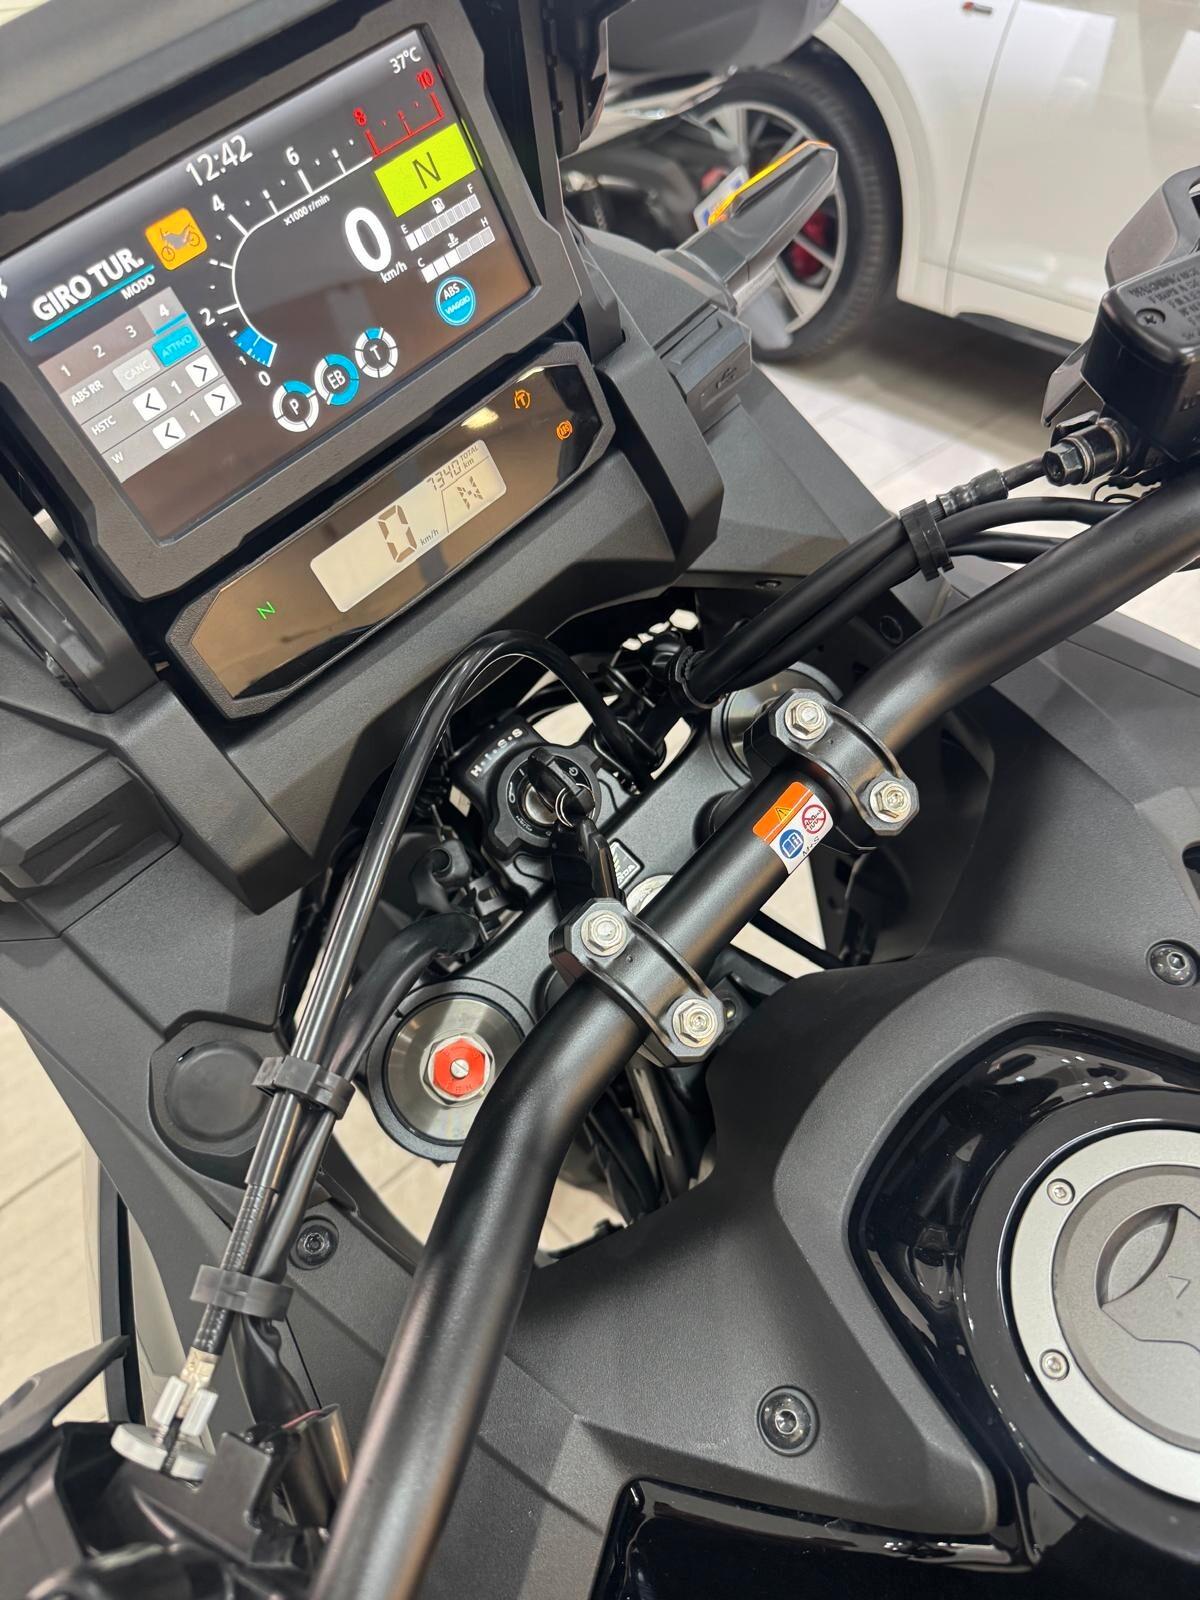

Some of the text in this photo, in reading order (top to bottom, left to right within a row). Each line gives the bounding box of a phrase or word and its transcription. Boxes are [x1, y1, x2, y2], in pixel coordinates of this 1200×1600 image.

[389, 46, 421, 74] 37°C
[416, 68, 435, 89] 10
[353, 107, 367, 127] 8
[185, 134, 253, 187] 12:42
[286, 147, 300, 167] 6
[412, 151, 442, 190] N
[467, 183, 475, 194] F
[212, 194, 226, 213] 4
[283, 194, 331, 226] x1000 r/min
[400, 223, 409, 235] E
[480, 216, 489, 228] H
[345, 206, 392, 272] 0
[380, 260, 408, 284] km/h
[417, 257, 426, 268] C
[32, 248, 145, 321] GIRO TUR.
[120, 273, 156, 300] MODO
[443, 282, 461, 301] ABS
[444, 295, 471, 316] VIAGGIO
[199, 307, 216, 327] 2
[61, 303, 170, 377] 1 2 3 4
[161, 334, 193, 359] ATTIVO
[370, 345, 382, 362] T
[124, 359, 152, 380] CANC
[258, 370, 271, 387] 0
[171, 380, 182, 395] 1
[327, 370, 346, 390] EB
[71, 379, 104, 407] ABS RR
[190, 409, 201, 424] 1
[289, 398, 299, 416] P
[91, 415, 117, 436] HSTC
[111, 451, 124, 465] W
[463, 458, 475, 470] km
[427, 445, 480, 492] 7340 TOTAL
[456, 475, 484, 510] N
[378, 504, 418, 564] 0
[420, 528, 440, 547] km/h
[257, 601, 276, 621] N
